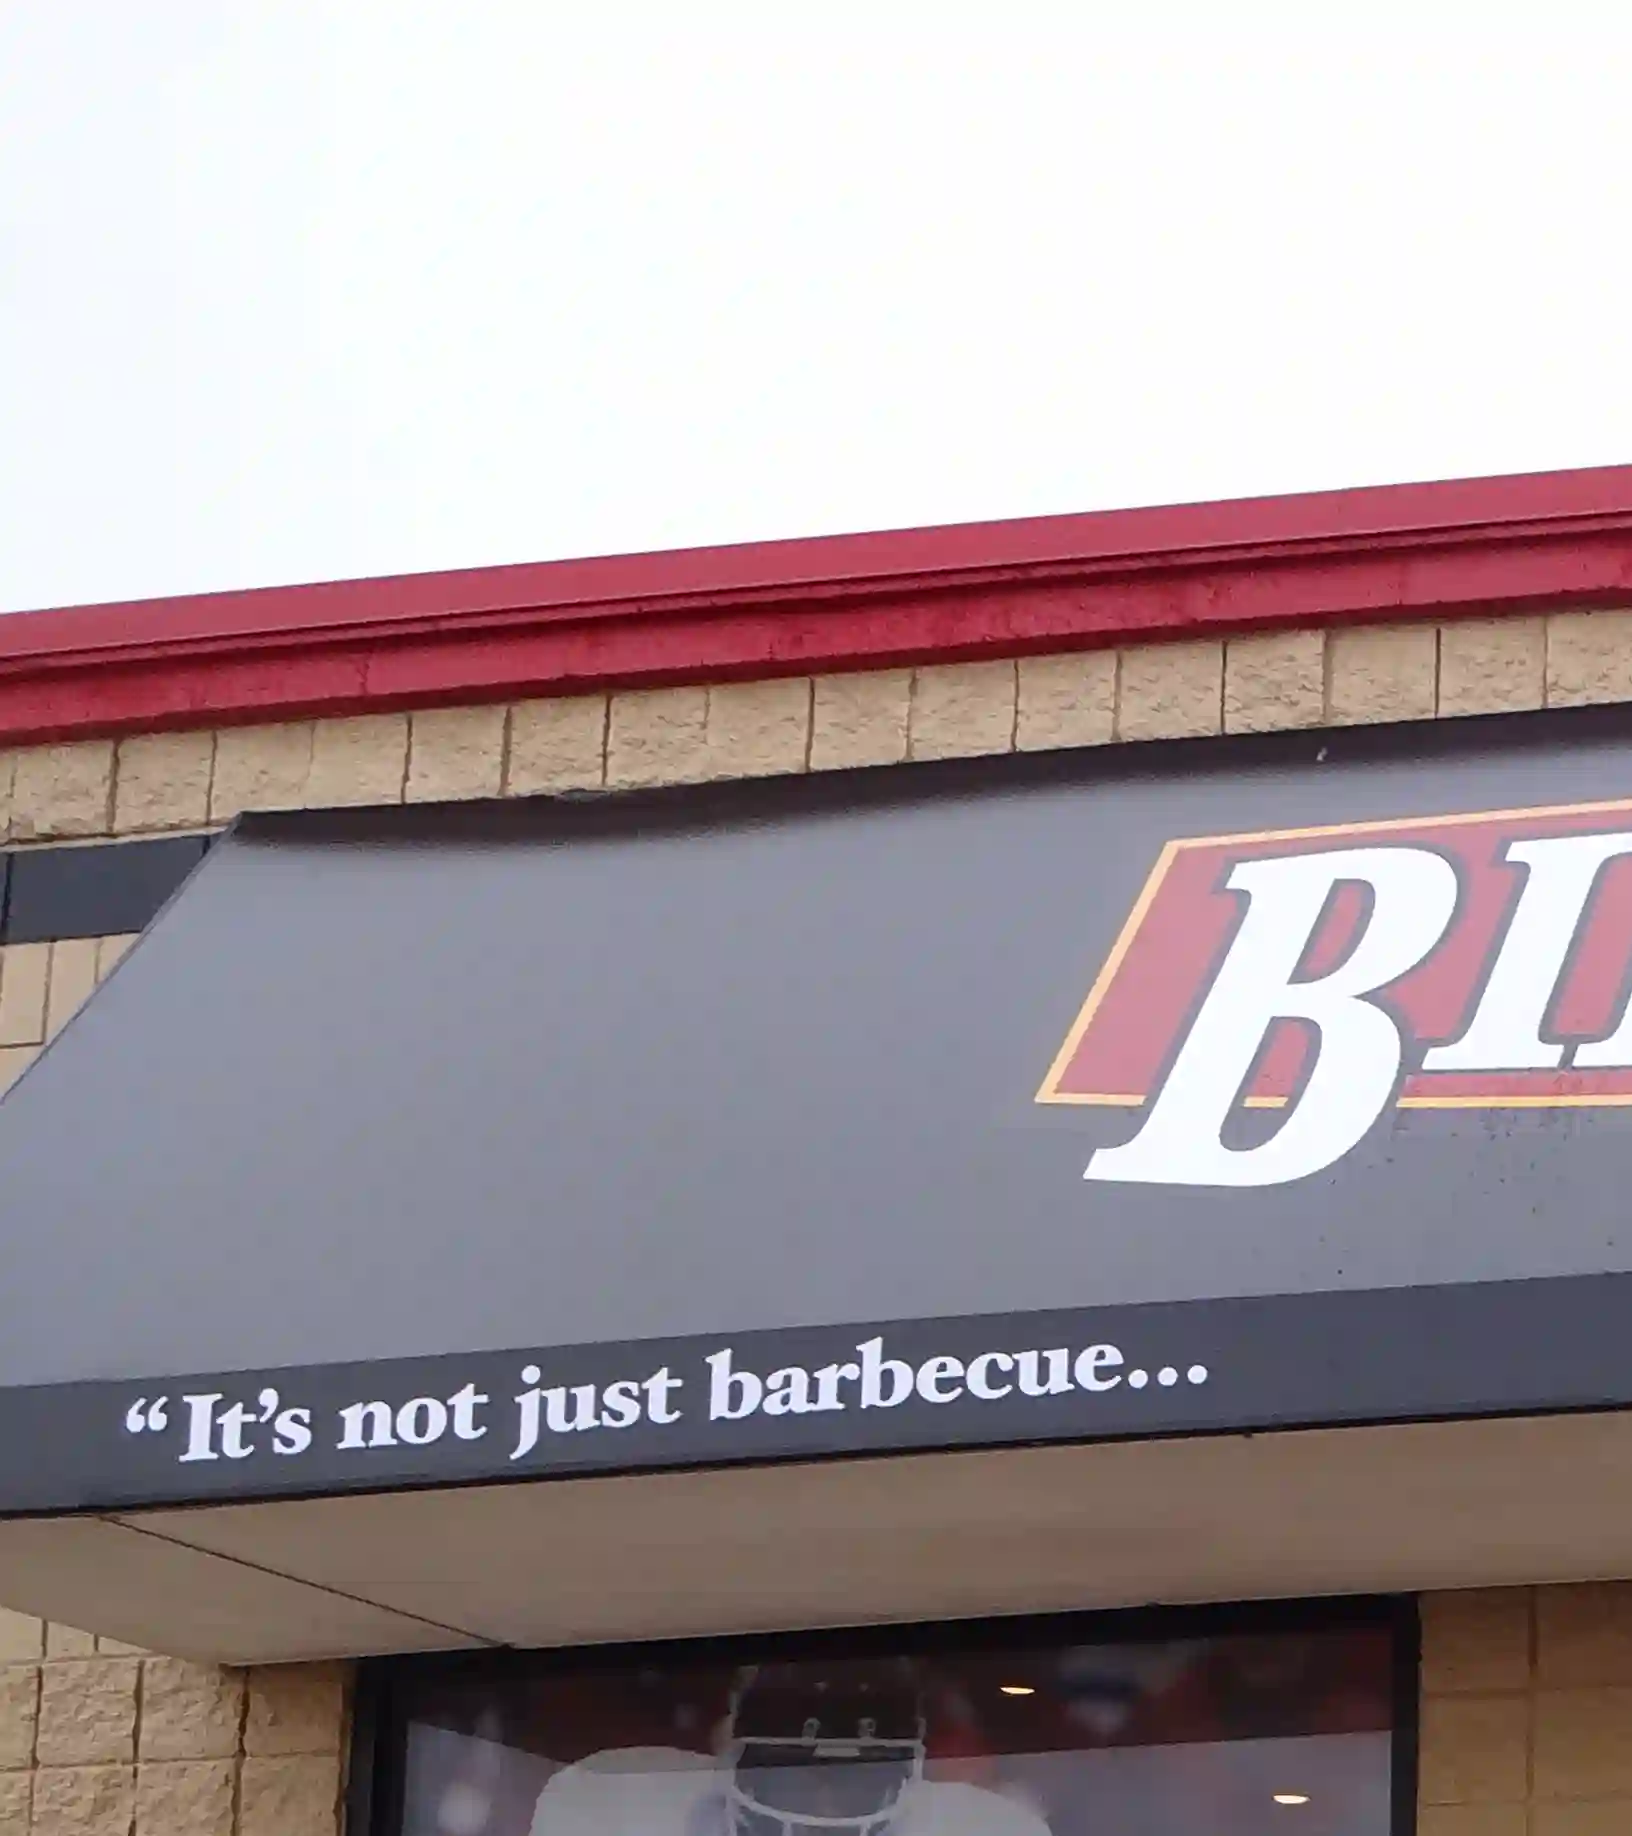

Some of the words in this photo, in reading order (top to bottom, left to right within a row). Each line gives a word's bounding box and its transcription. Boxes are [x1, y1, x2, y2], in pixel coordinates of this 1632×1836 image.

[336, 1383, 489, 1450] not
[509, 1365, 684, 1460] just
[706, 1336, 1208, 1421] barbecue...
